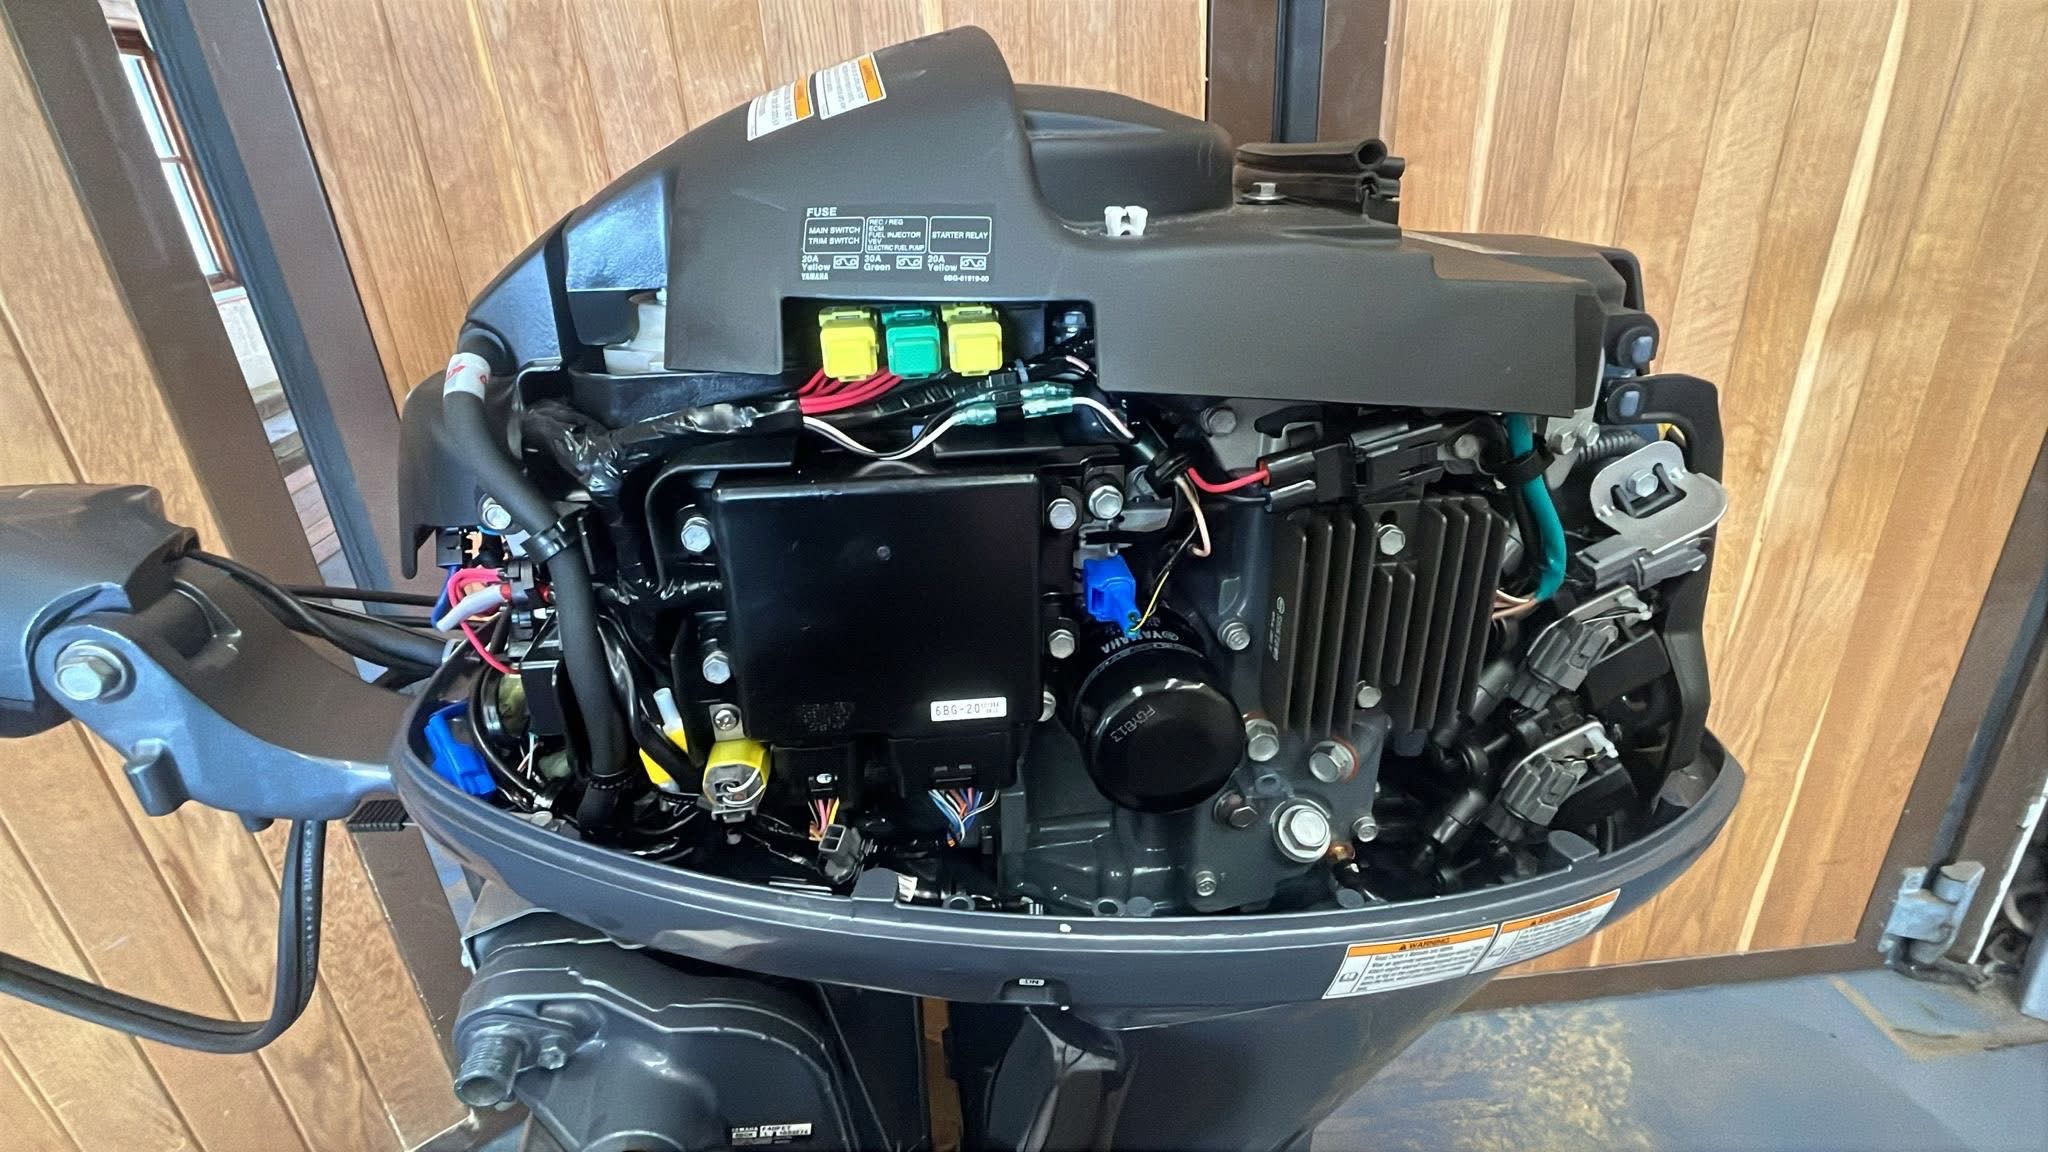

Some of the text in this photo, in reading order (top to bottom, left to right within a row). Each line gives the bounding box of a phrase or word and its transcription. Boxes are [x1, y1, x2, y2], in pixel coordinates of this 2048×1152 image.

[806, 207, 837, 217] FUSE
[829, 226, 861, 234] SWITCH
[932, 231, 988, 239] STARTER RELAY
[808, 236, 860, 245] TRIM SWITCH
[801, 255, 819, 263] 20A
[864, 254, 882, 263] 30A
[927, 254, 945, 263] 20A
[801, 263, 831, 271] Yellow
[863, 263, 891, 271] Green
[927, 263, 958, 272] Yellow
[303, 840, 313, 891] POSITIVE
